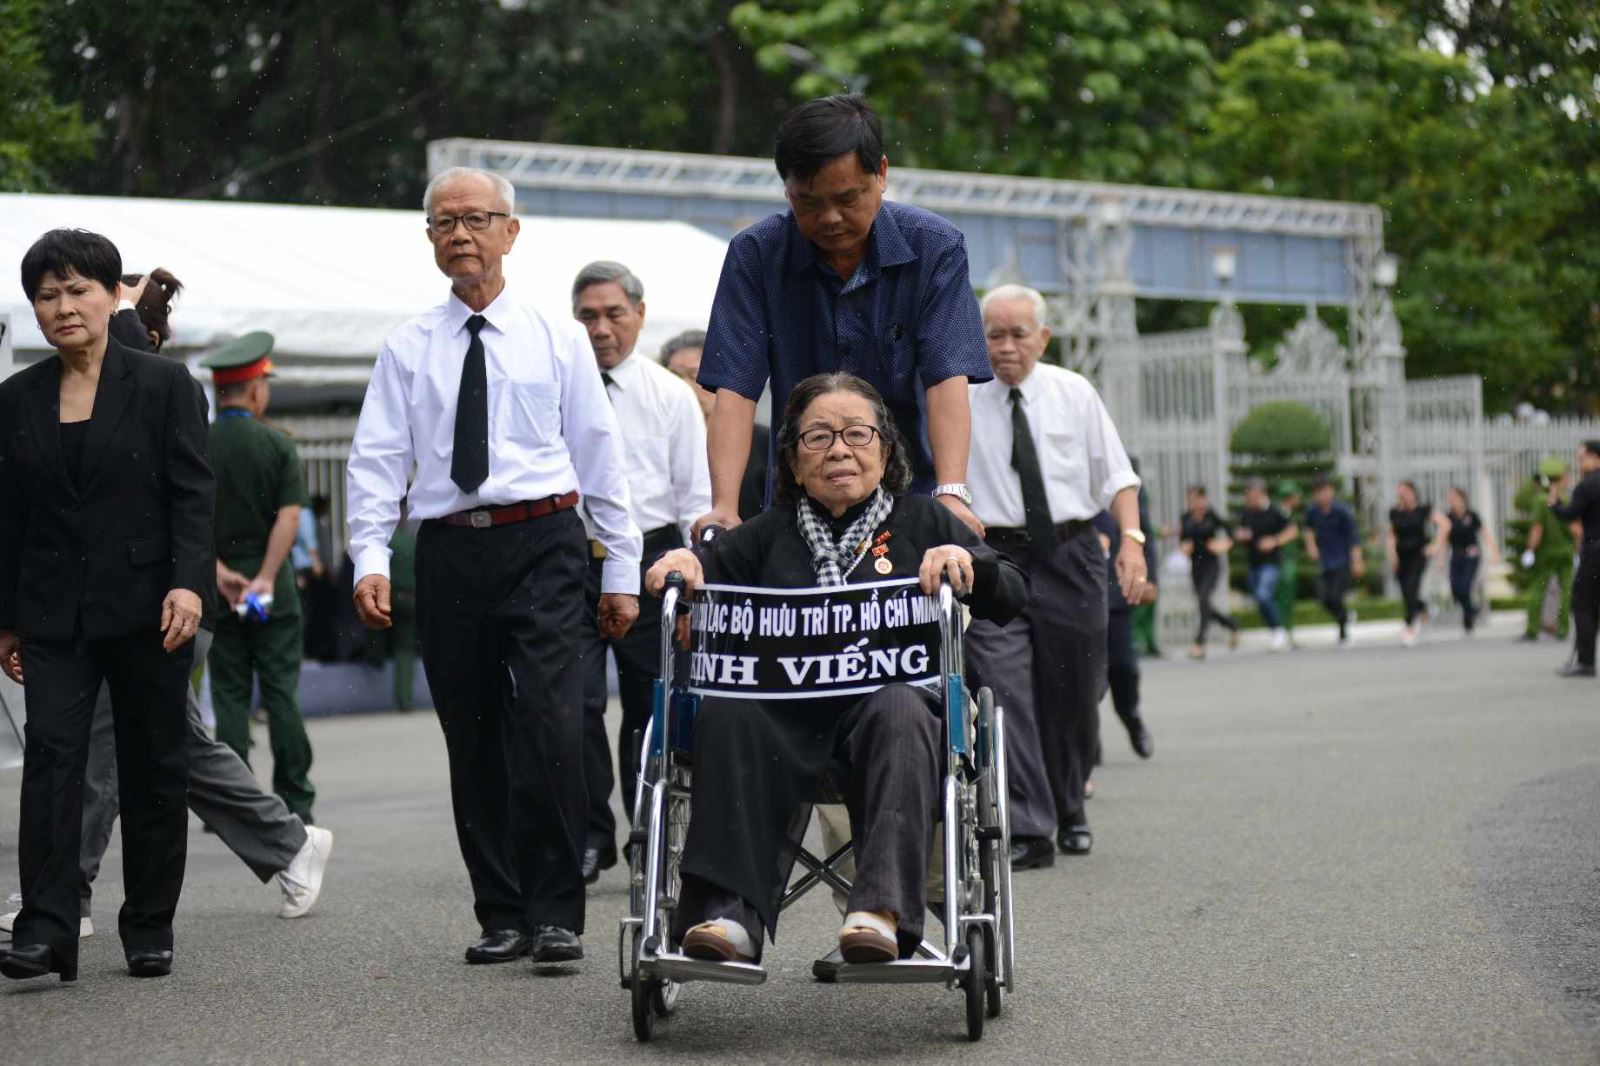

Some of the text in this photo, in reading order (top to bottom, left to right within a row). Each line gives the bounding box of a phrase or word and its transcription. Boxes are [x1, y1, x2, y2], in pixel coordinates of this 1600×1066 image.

[707, 603, 728, 639] LẠC
[730, 598, 754, 641] BỘ
[759, 602, 797, 637] HƯU
[801, 599, 830, 636] TRÍ
[832, 604, 857, 634] TP.
[861, 589, 881, 631] HỒ
[884, 590, 909, 628] CHÍ
[777, 638, 930, 686] VIẾNG
